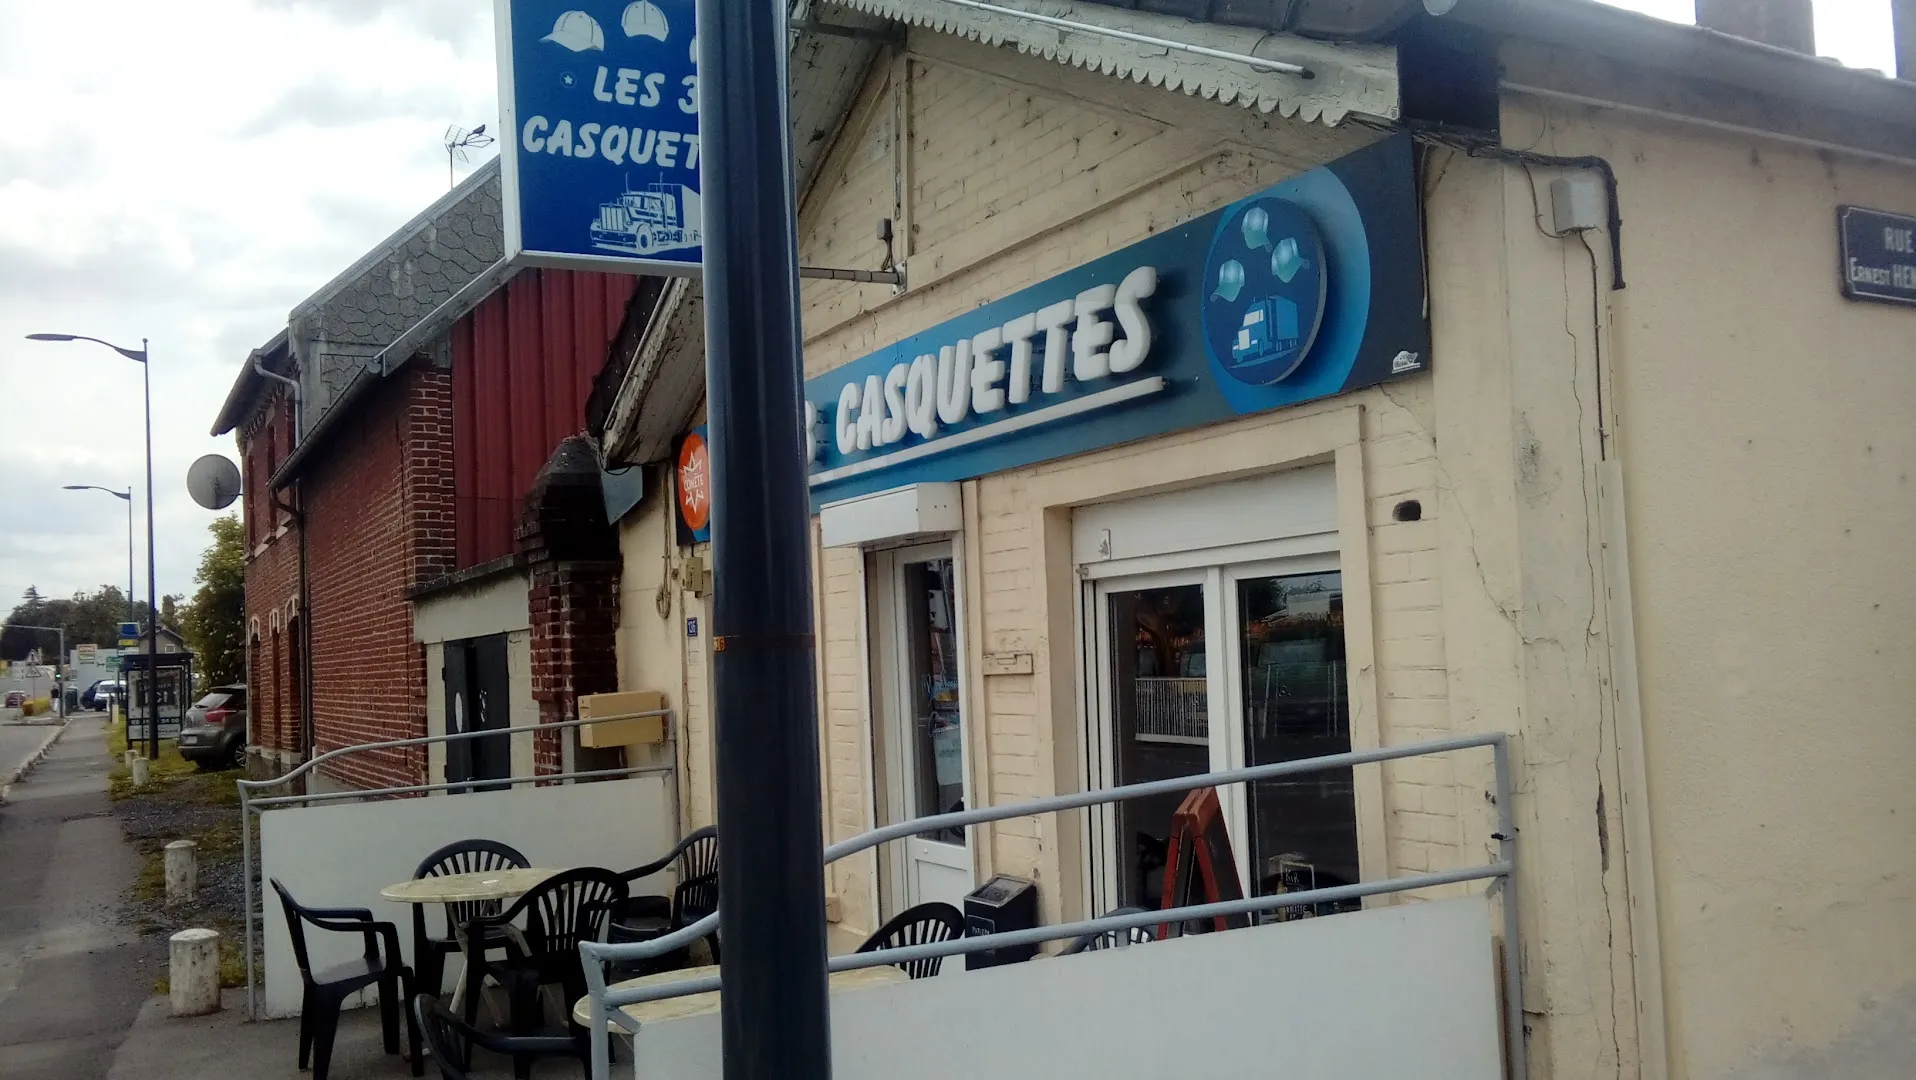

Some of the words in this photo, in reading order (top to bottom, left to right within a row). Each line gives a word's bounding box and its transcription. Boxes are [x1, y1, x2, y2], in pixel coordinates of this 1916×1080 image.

[593, 65, 665, 107] LES
[678, 75, 699, 114] 3
[1884, 227, 1914, 253] RUE
[835, 265, 1159, 455] CASQUETTES
